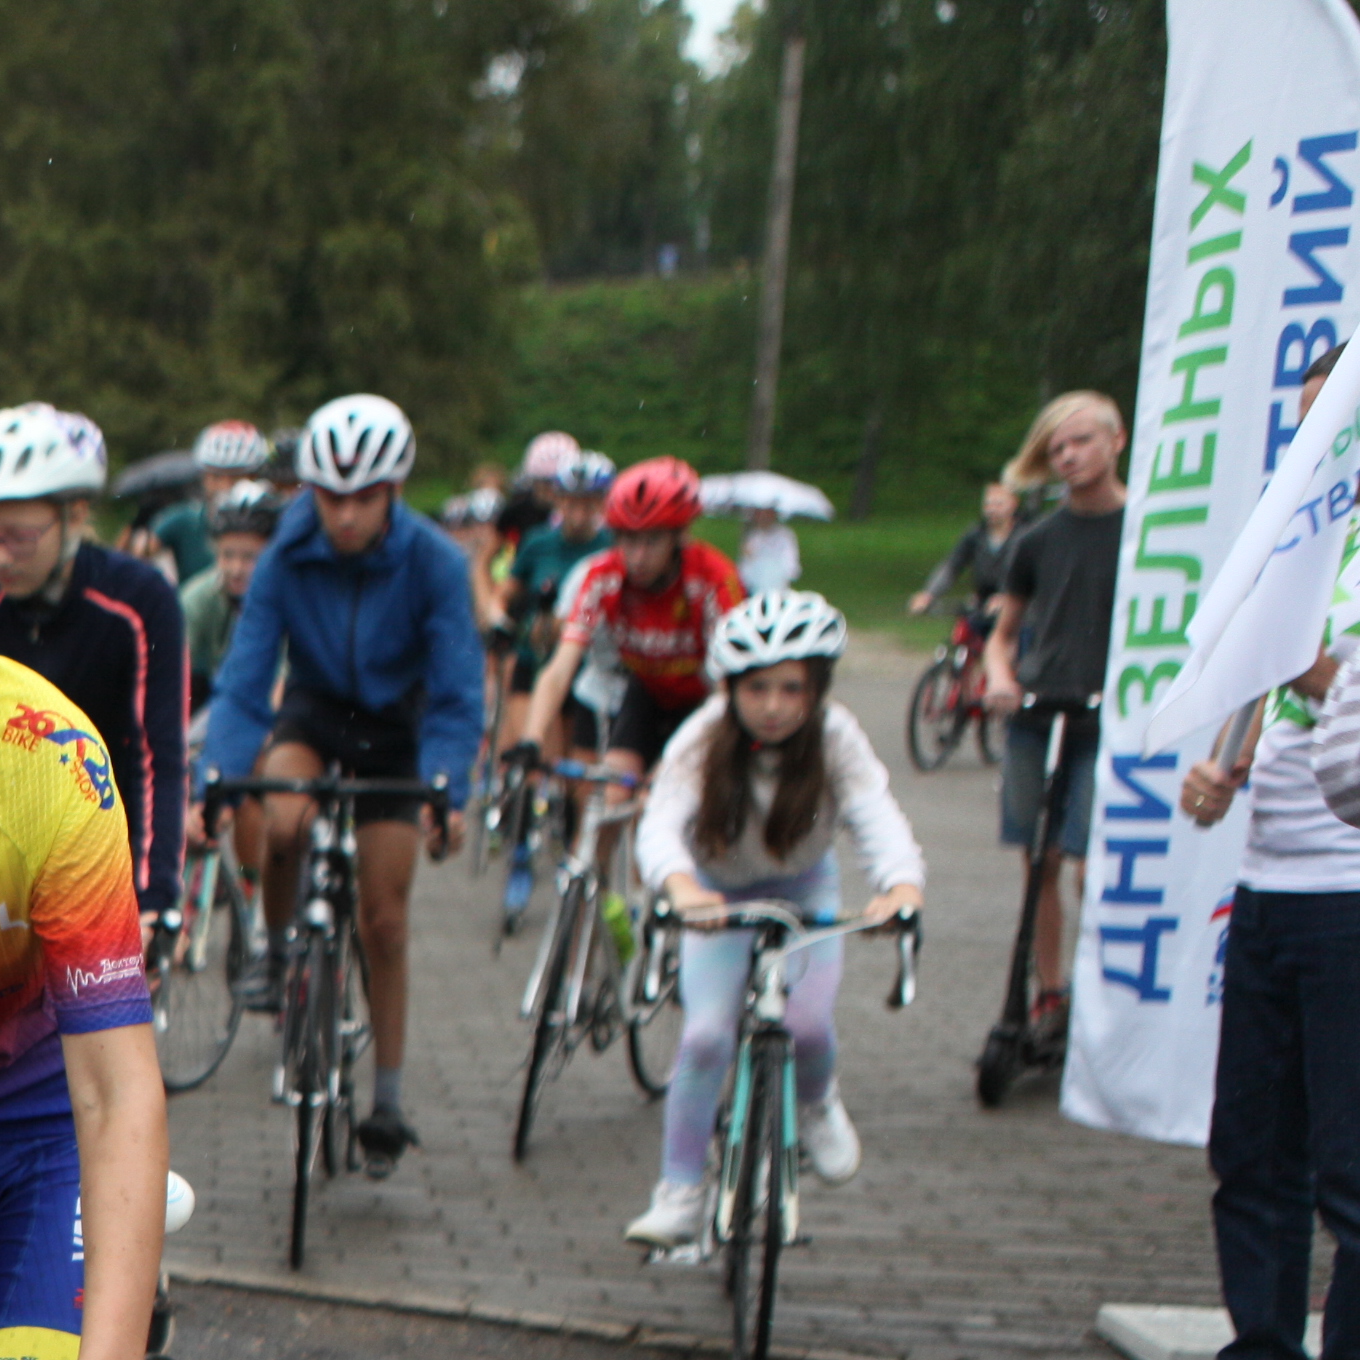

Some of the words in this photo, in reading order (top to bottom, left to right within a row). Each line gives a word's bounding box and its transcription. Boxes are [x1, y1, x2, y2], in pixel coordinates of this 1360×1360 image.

[1117, 138, 1255, 722] ЗЕЛЕНЫХ
[1258, 129, 1360, 498] ТВИЙ
[2, 726, 42, 752] BIKE
[69, 758, 98, 803] SHOP
[1099, 751, 1179, 1004] ДНИ
